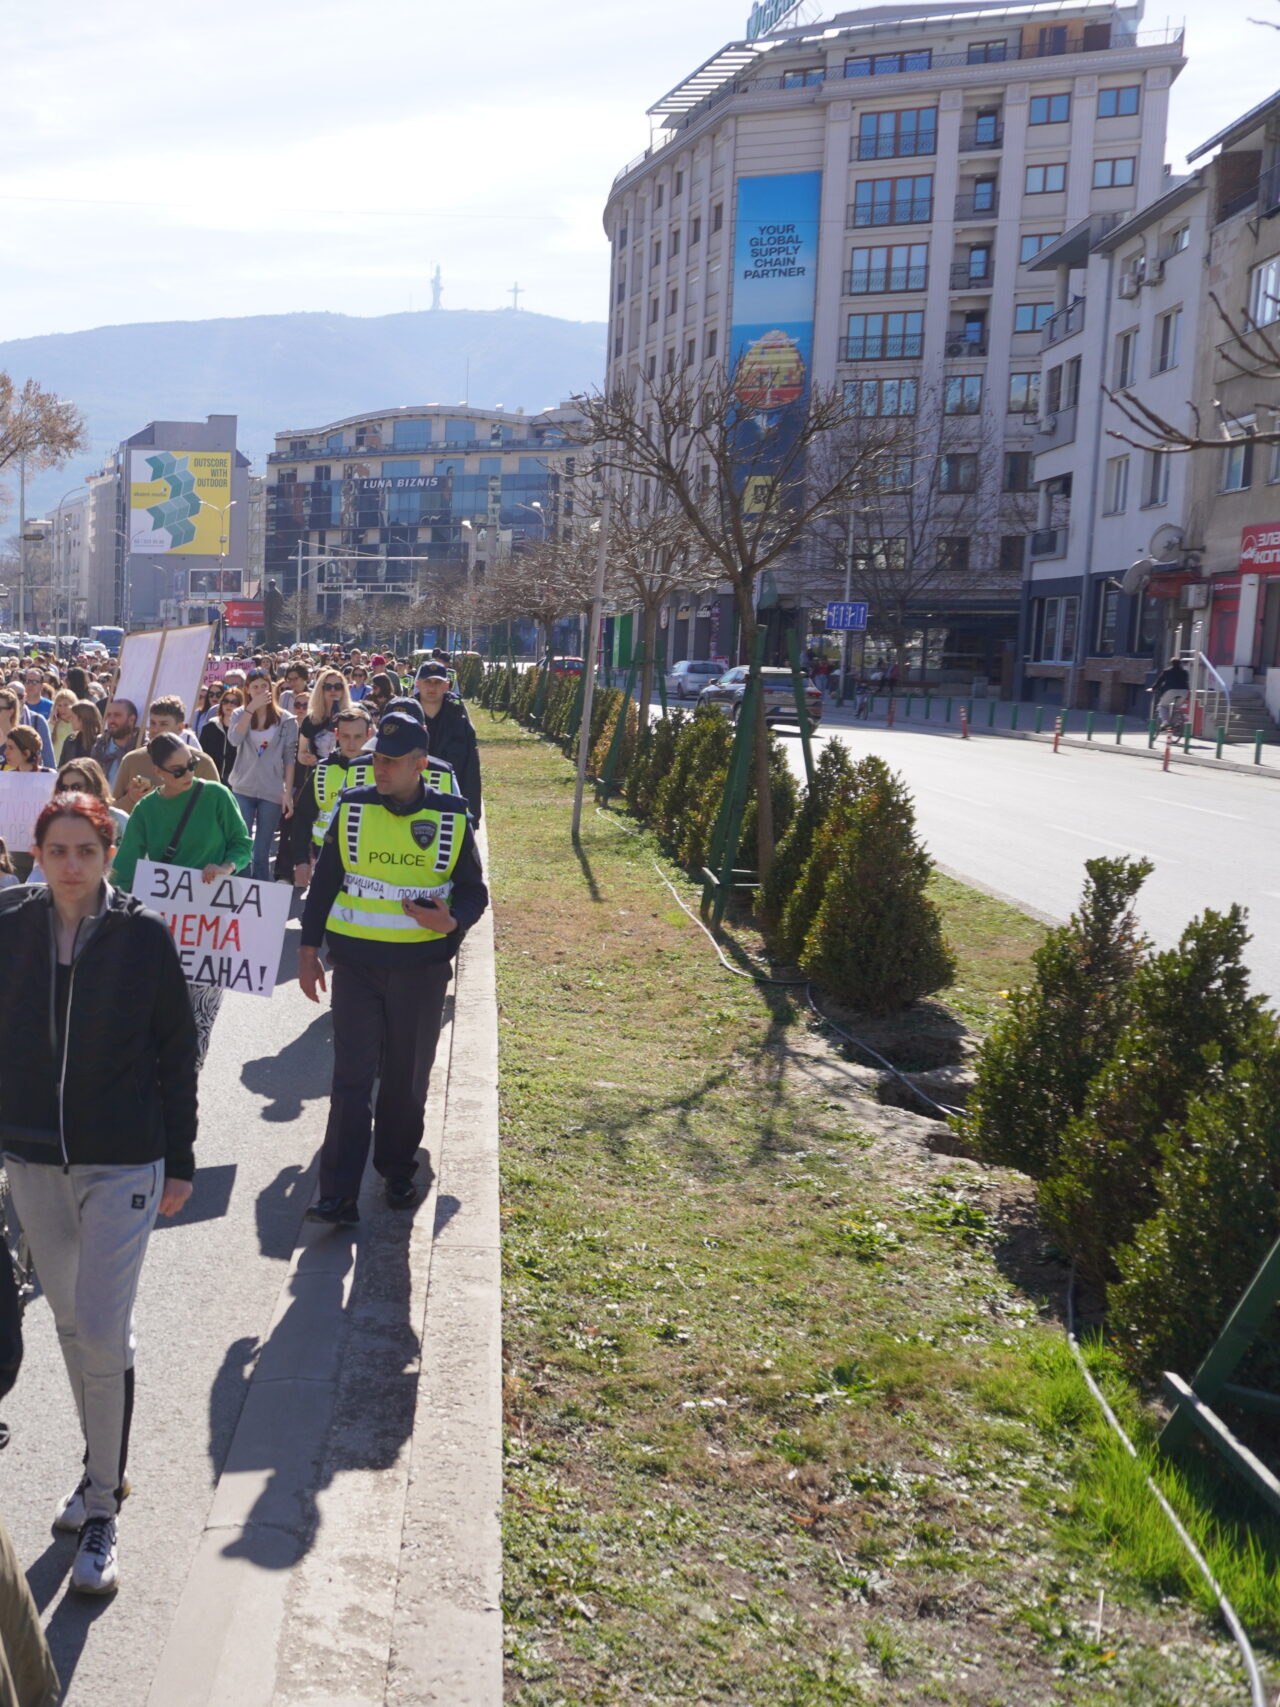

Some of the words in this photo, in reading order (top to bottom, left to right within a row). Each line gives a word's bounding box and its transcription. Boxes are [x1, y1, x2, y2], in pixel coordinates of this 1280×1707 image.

[758, 224, 796, 235] YOUR
[749, 234, 803, 247] GLOBAL
[750, 245, 801, 258] SUPPLY
[754, 257, 796, 268] CHAIN
[744, 267, 806, 279] PARTNER
[194, 458, 228, 468] OUTSCORE
[210, 469, 228, 478] WITH
[197, 479, 228, 488] OUTDOOR
[363, 479, 393, 489] LUNA
[397, 477, 439, 488] BIZNIS
[368, 851, 426, 867] POLICE
[150, 868, 194, 902] ЗА
[209, 879, 262, 917] ДА
